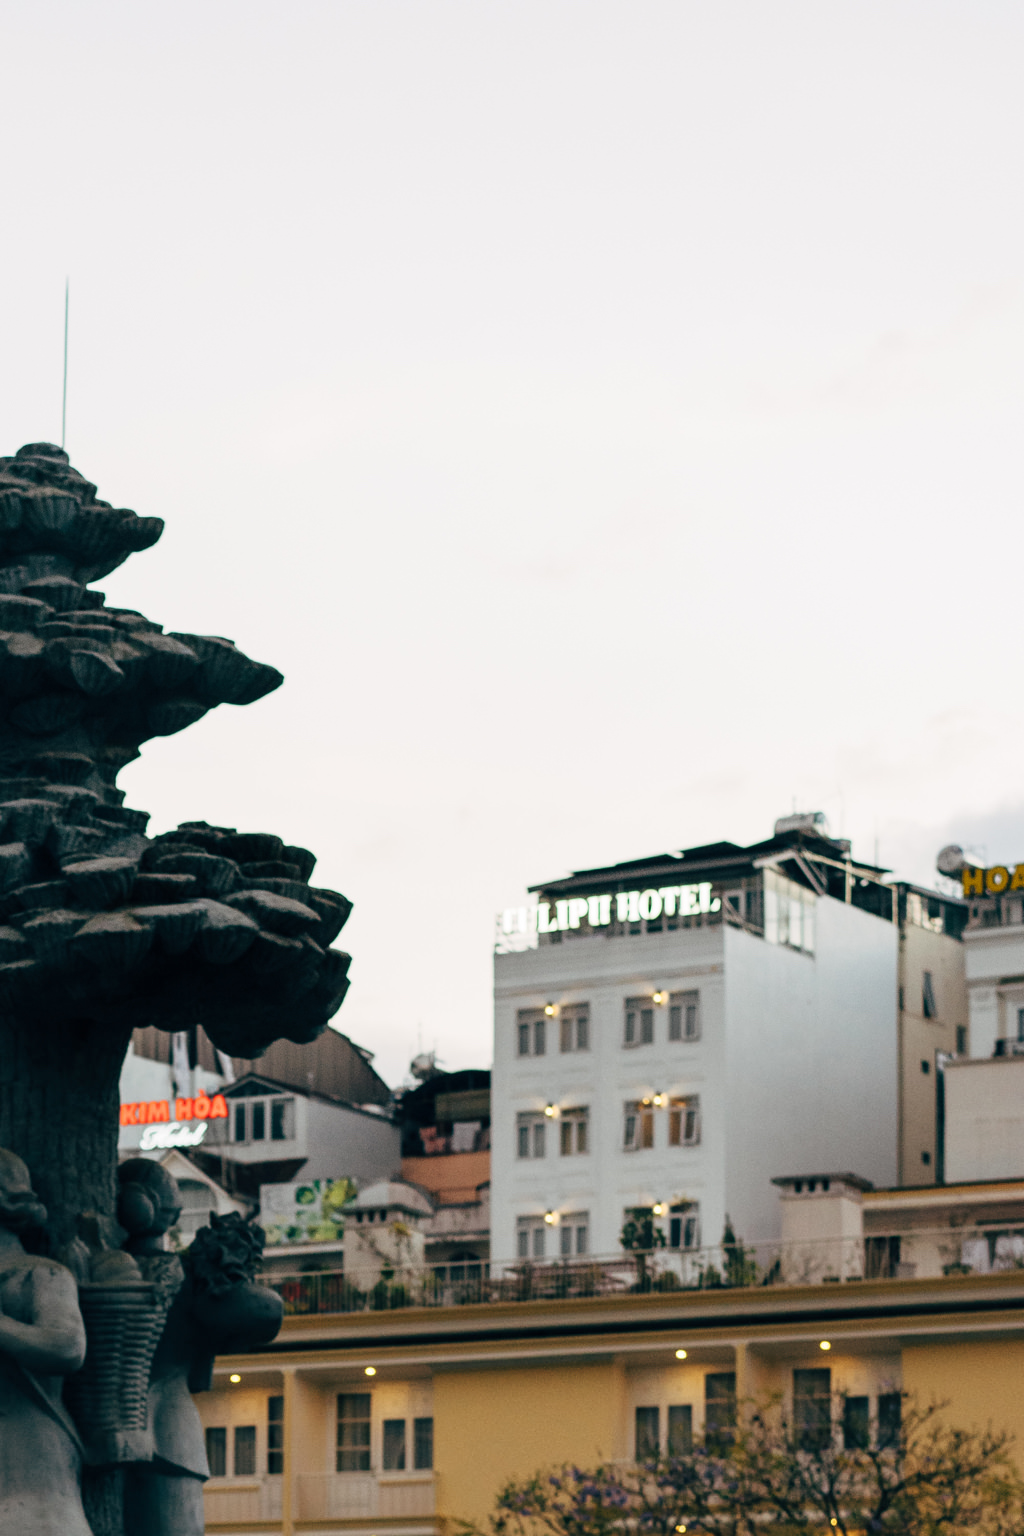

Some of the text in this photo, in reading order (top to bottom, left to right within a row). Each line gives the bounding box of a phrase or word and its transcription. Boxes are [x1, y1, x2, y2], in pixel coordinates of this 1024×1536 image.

[615, 881, 722, 923] HOTEL
[120, 1089, 228, 1126] KIM HÒA
